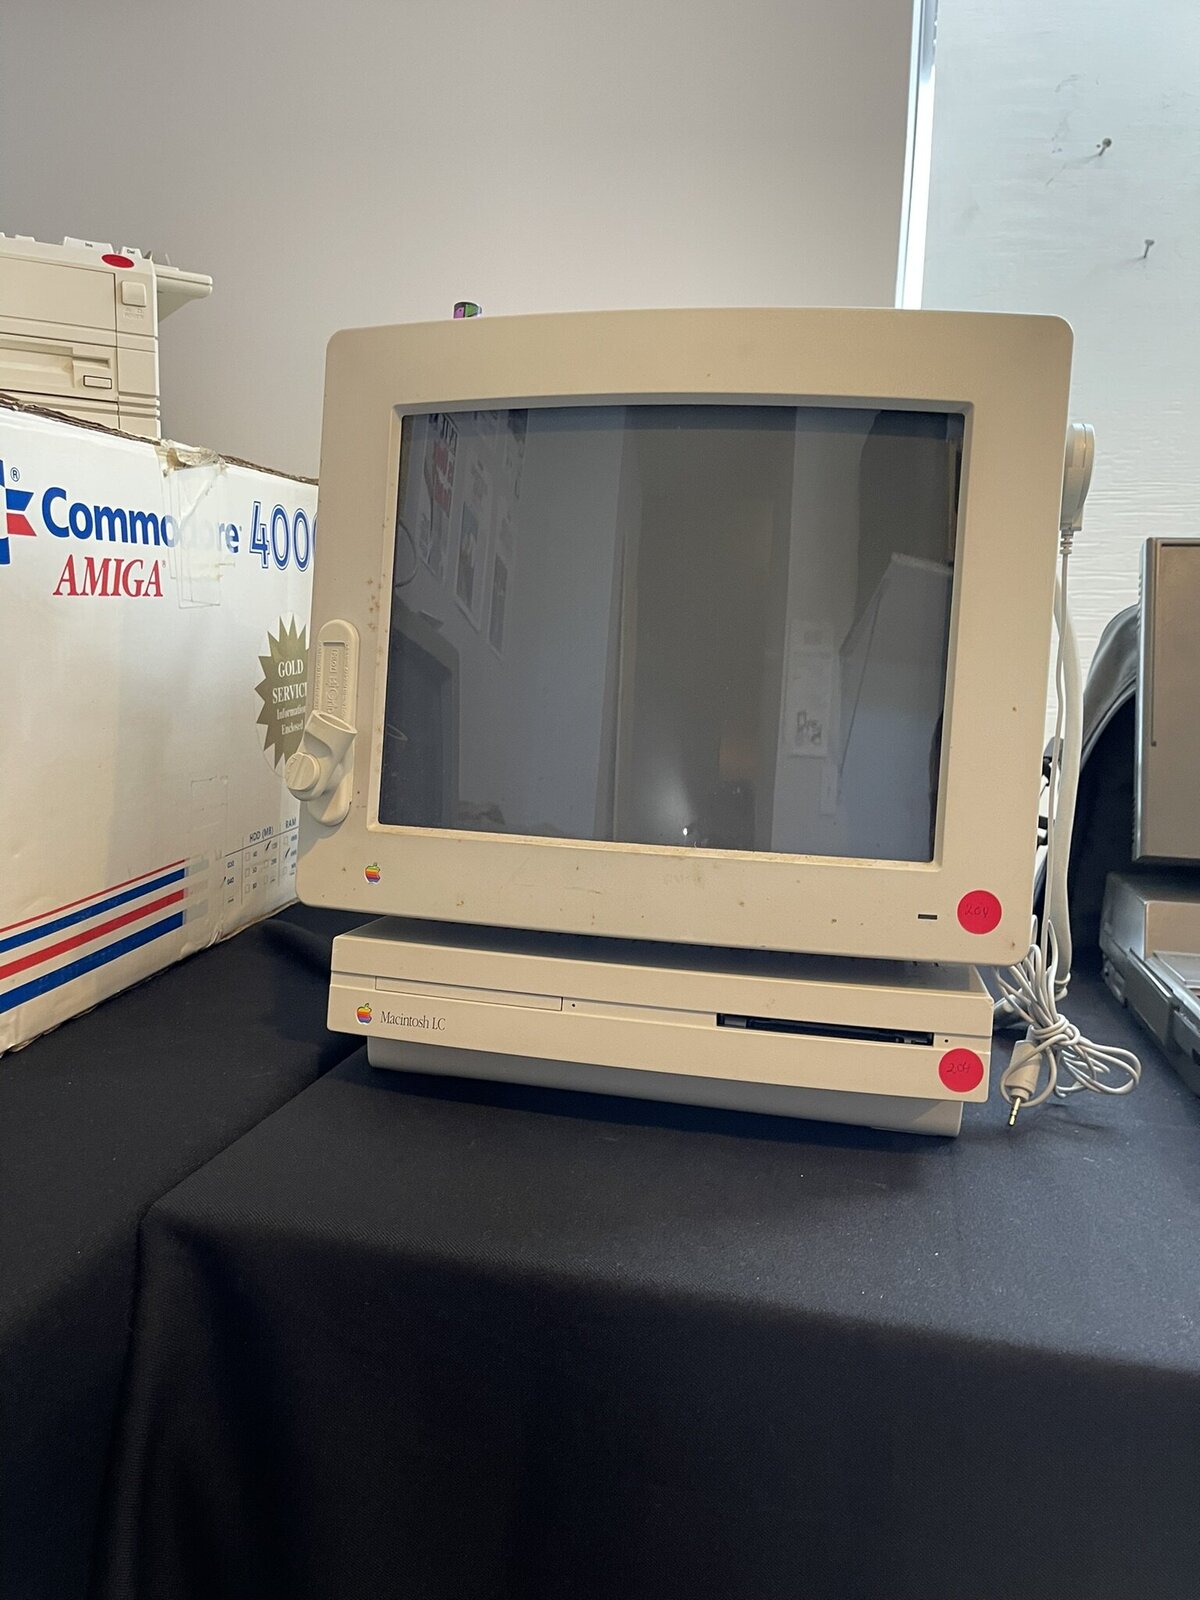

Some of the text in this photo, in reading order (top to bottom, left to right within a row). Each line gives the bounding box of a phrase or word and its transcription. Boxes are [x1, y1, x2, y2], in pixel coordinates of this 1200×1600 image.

[41, 487, 317, 572] Commore 400
[278, 659, 304, 678] GOLD
[380, 1011, 446, 1031] Macintosh LC
